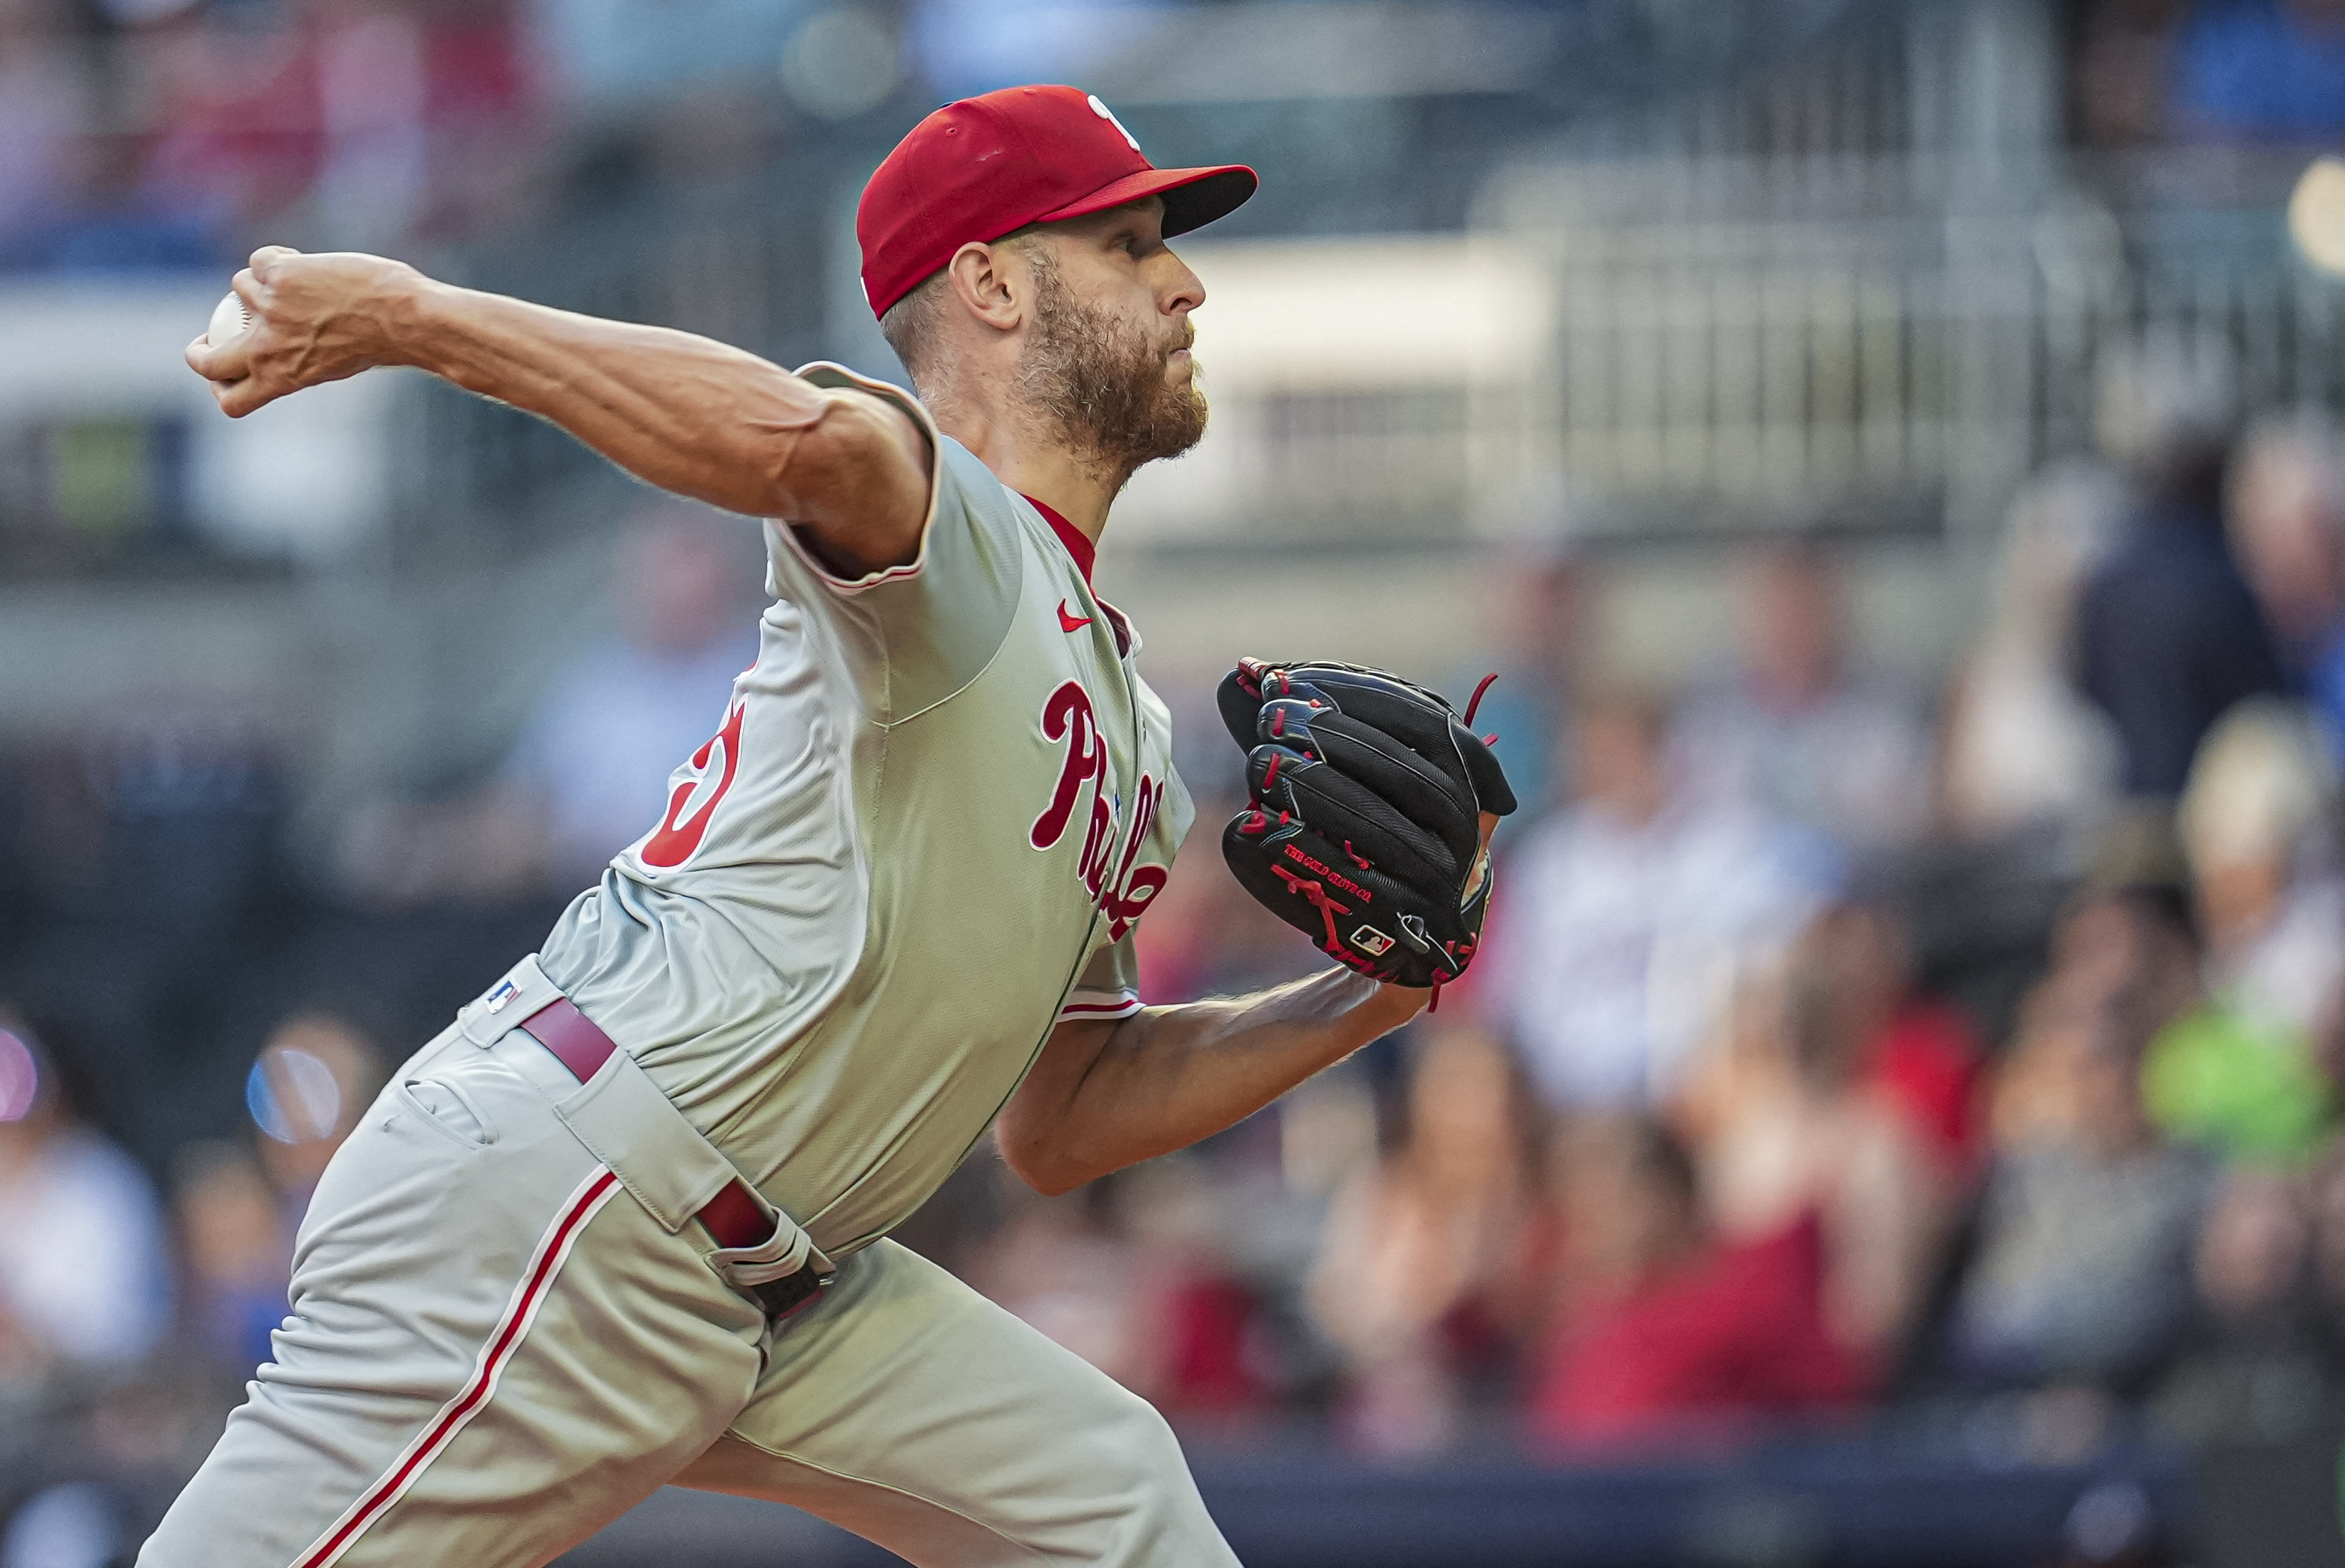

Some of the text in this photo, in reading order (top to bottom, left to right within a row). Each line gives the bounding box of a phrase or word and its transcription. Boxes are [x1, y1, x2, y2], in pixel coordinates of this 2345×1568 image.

[1284, 843, 1305, 863] THE
[1303, 856, 1329, 876] GOLD
[1327, 872, 1359, 894] GLOVE
